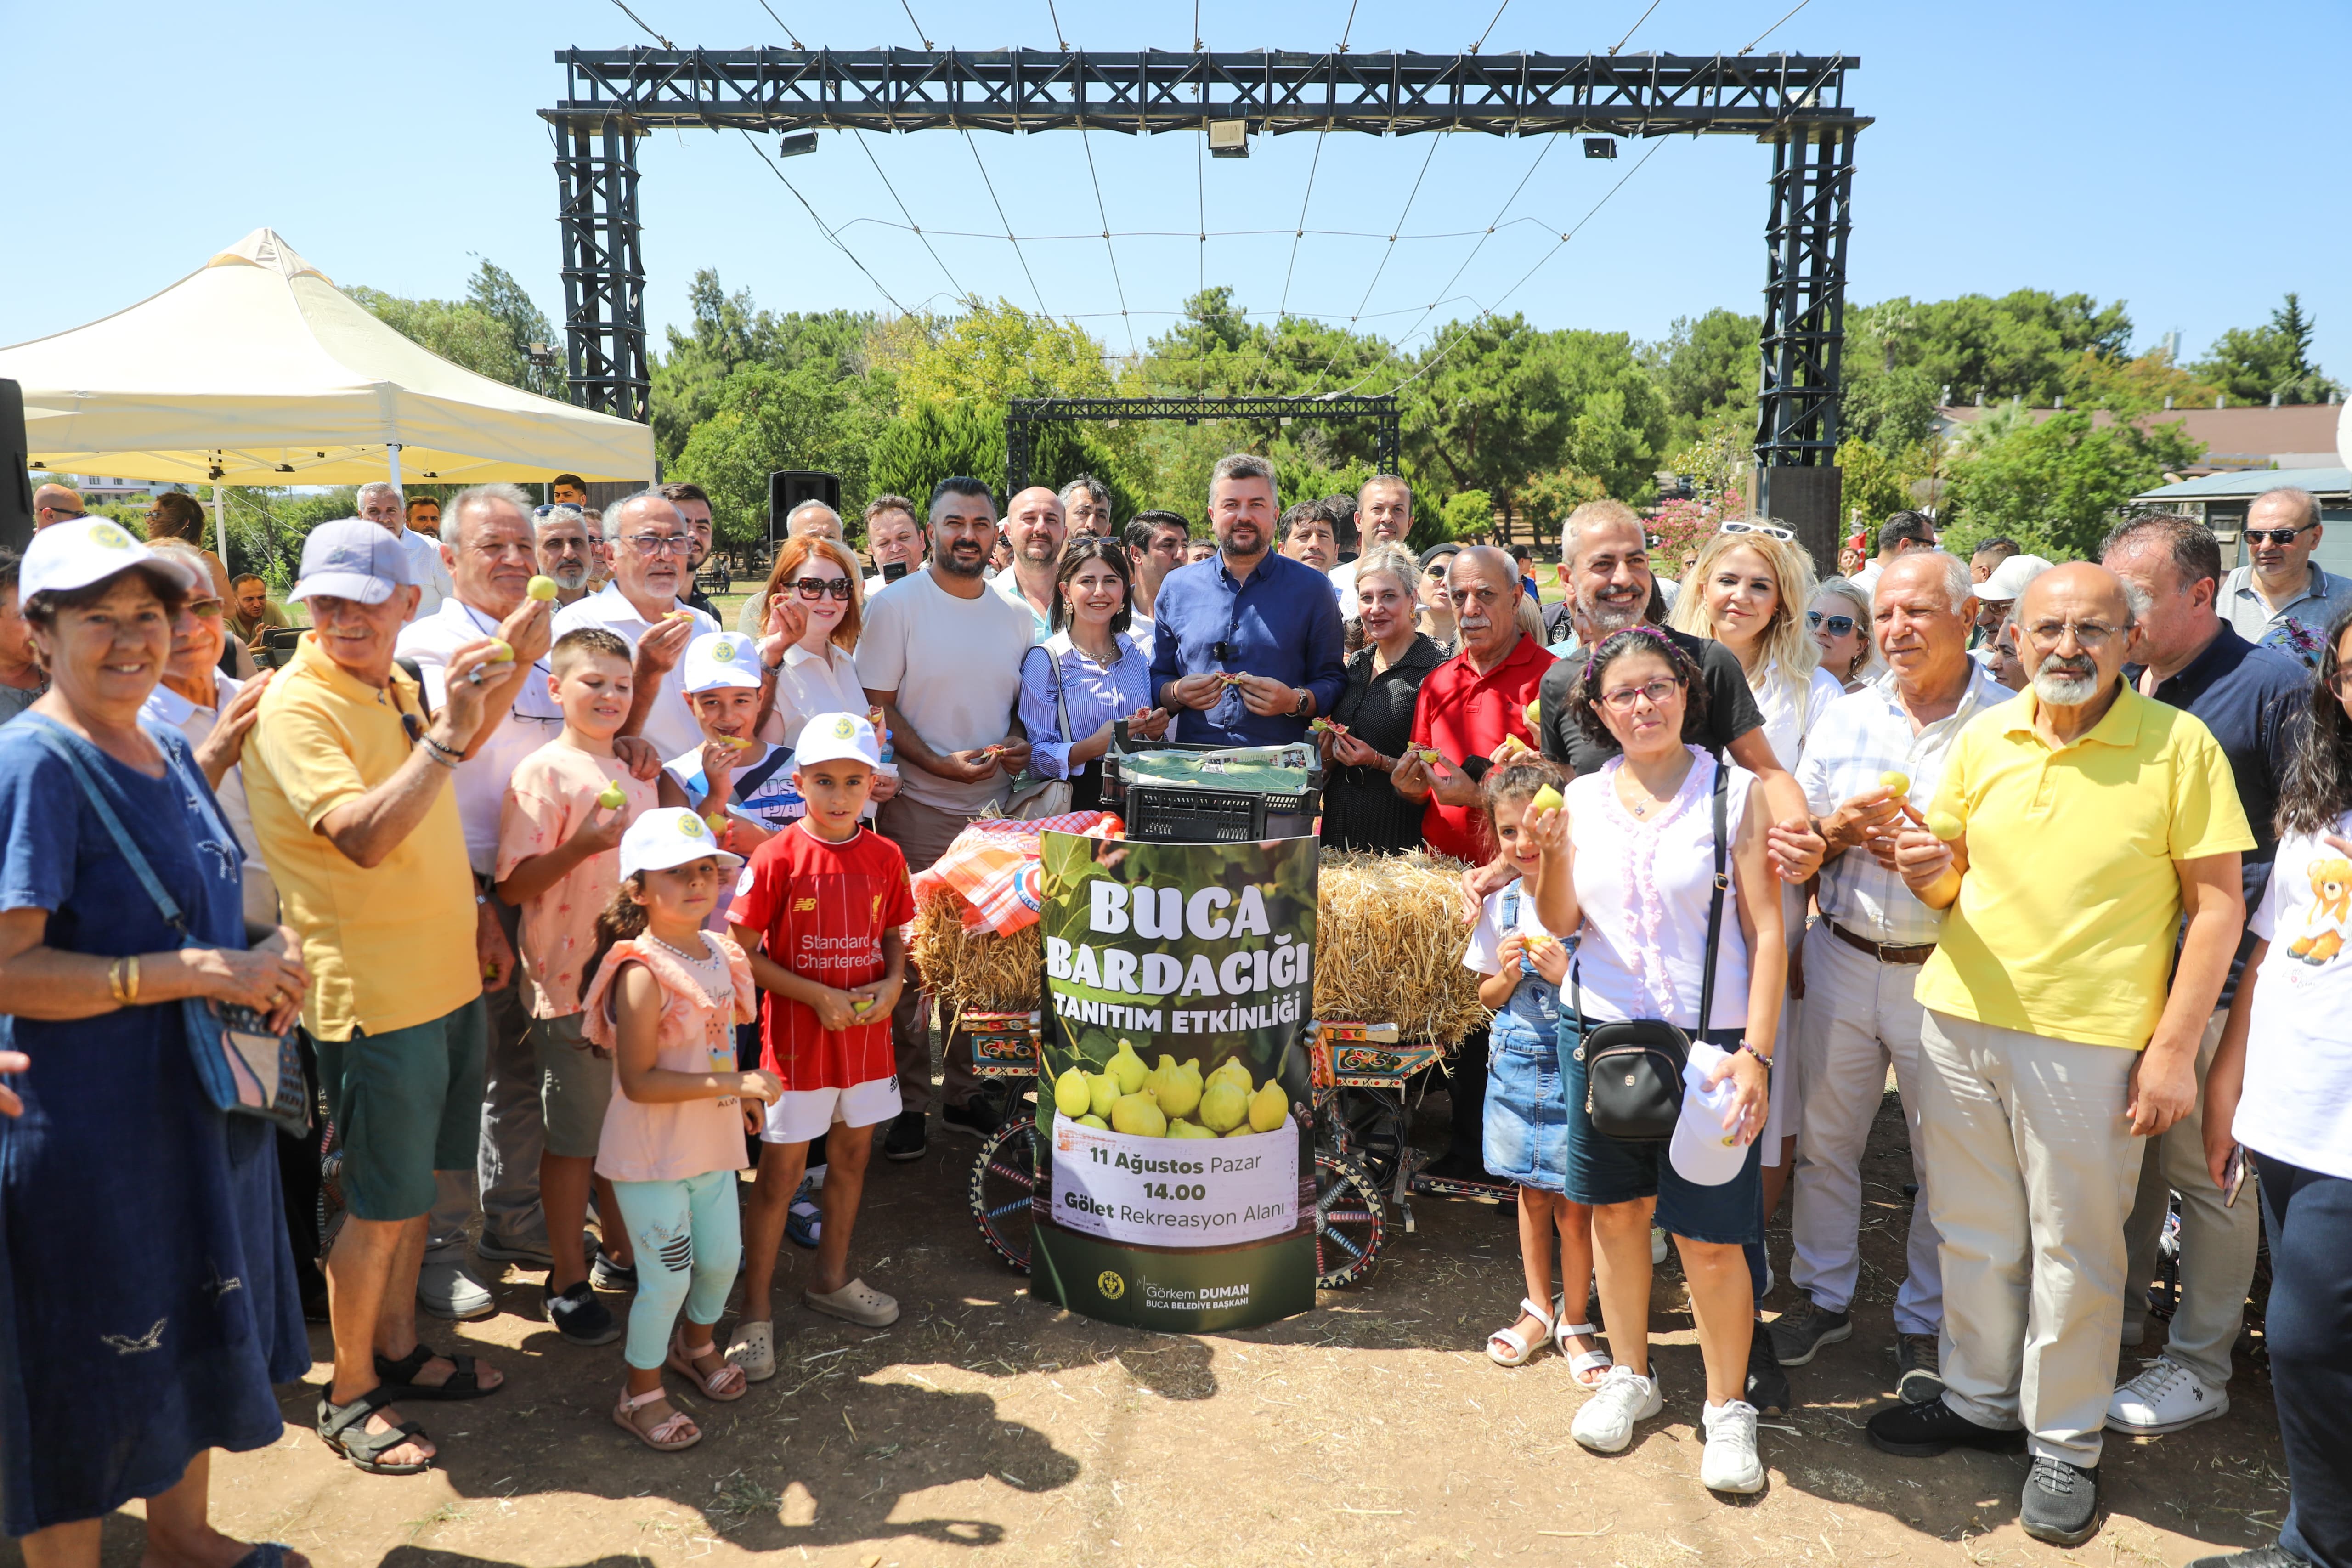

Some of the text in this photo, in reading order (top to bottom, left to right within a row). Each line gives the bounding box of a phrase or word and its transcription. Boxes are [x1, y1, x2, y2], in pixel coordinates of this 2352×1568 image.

[1090, 880, 1271, 940] BUCA
[802, 935, 869, 950] Standard
[796, 953, 870, 969] Chartered
[1046, 933, 1310, 996] BARDACIĞI
[1053, 991, 1300, 1033] TANITIM ETKİNLİĞİ
[1090, 1147, 1262, 1174] 11 Ağustos Pazar
[1143, 1182, 1206, 1200] 14.00
[1064, 1192, 1285, 1230] Gölet Rekreasyon Alanı
[1147, 1283, 1249, 1299] Görkem DUMAN
[1146, 1297, 1248, 1309] BUCA BELEDİYE BAŞKANI
